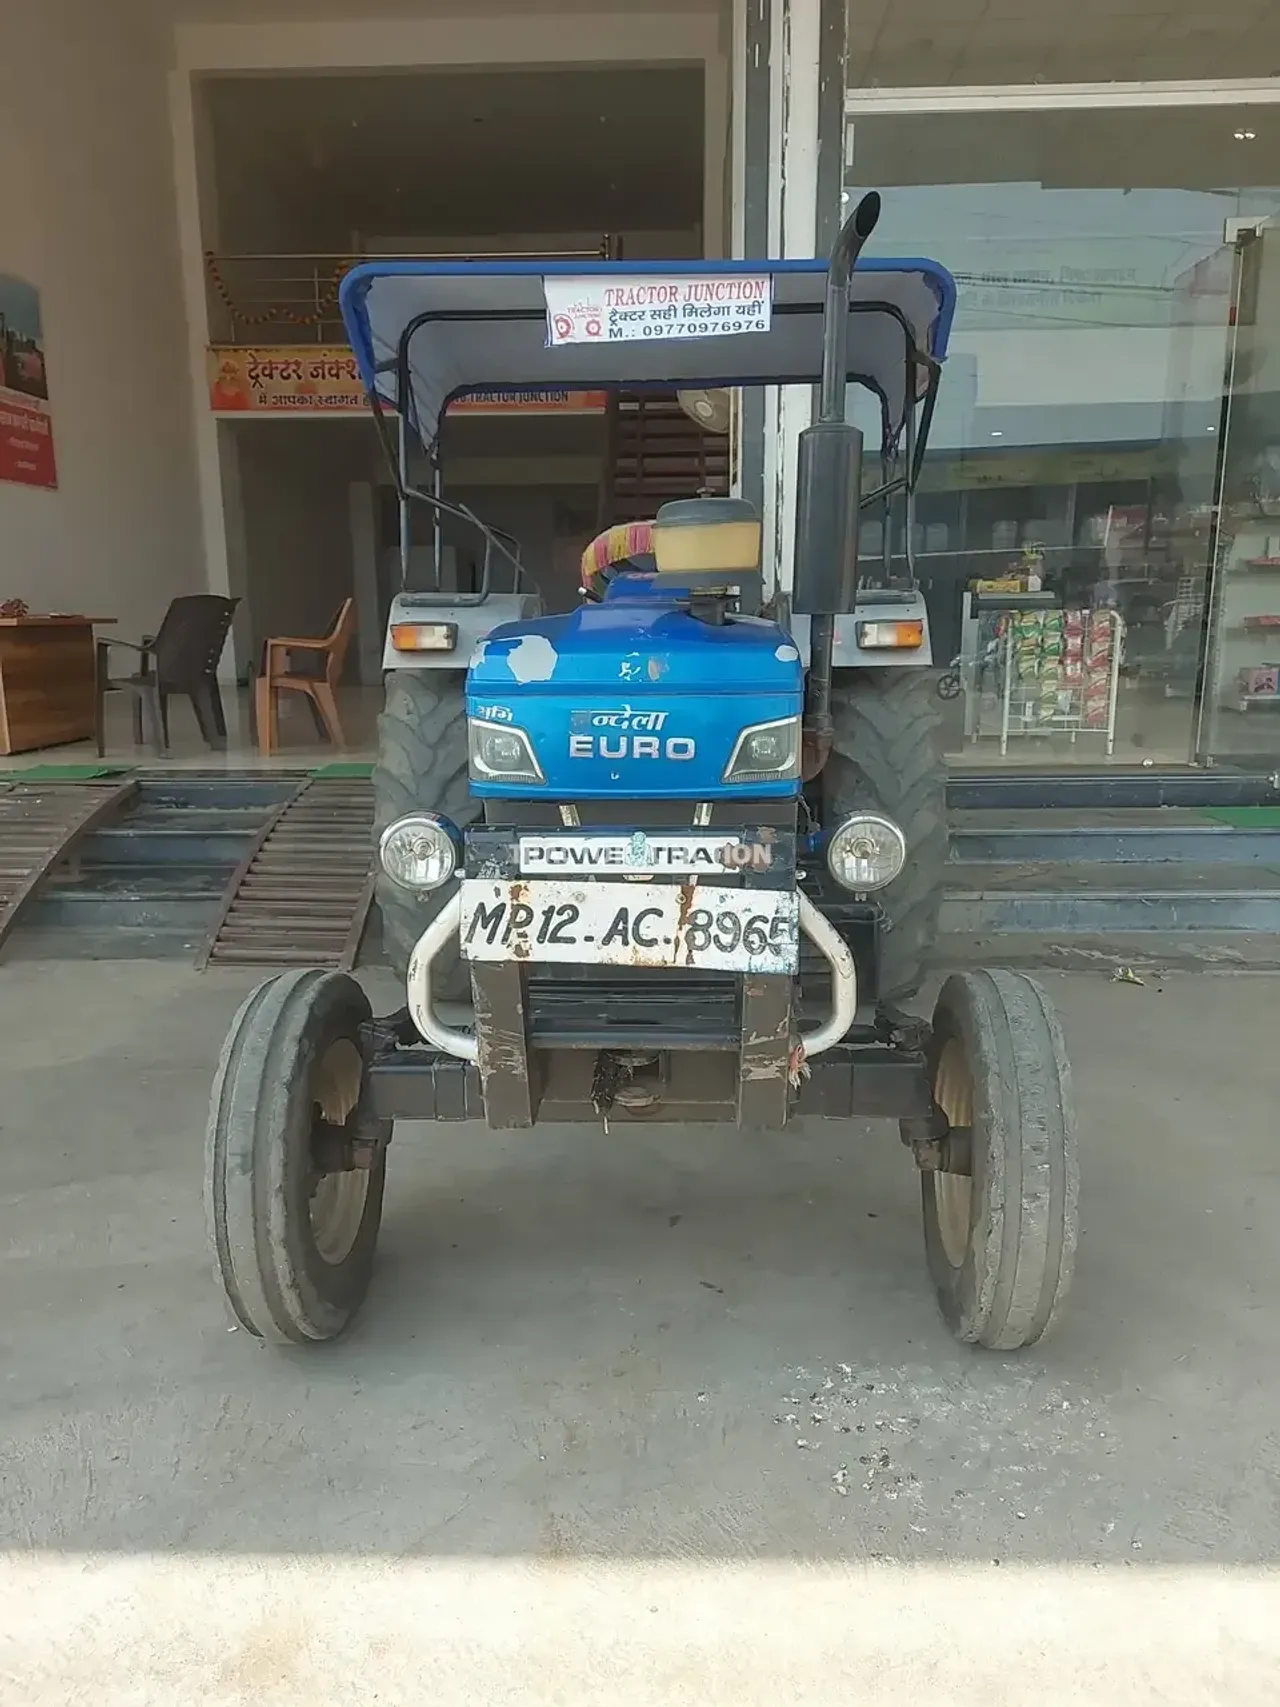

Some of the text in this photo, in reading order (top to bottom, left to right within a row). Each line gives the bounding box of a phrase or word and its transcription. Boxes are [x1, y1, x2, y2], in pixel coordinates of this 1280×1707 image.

[605, 280, 765, 307] TRACTOR JUNCTION
[650, 305, 677, 320] सही
[683, 303, 731, 319] मिलेगा
[736, 300, 765, 316] यहीं
[642, 320, 765, 337] 09770976976
[308, 354, 363, 380] जंक्श
[272, 393, 312, 405] आपका
[518, 390, 569, 404] JUNCTION
[569, 734, 696, 760] EURO
